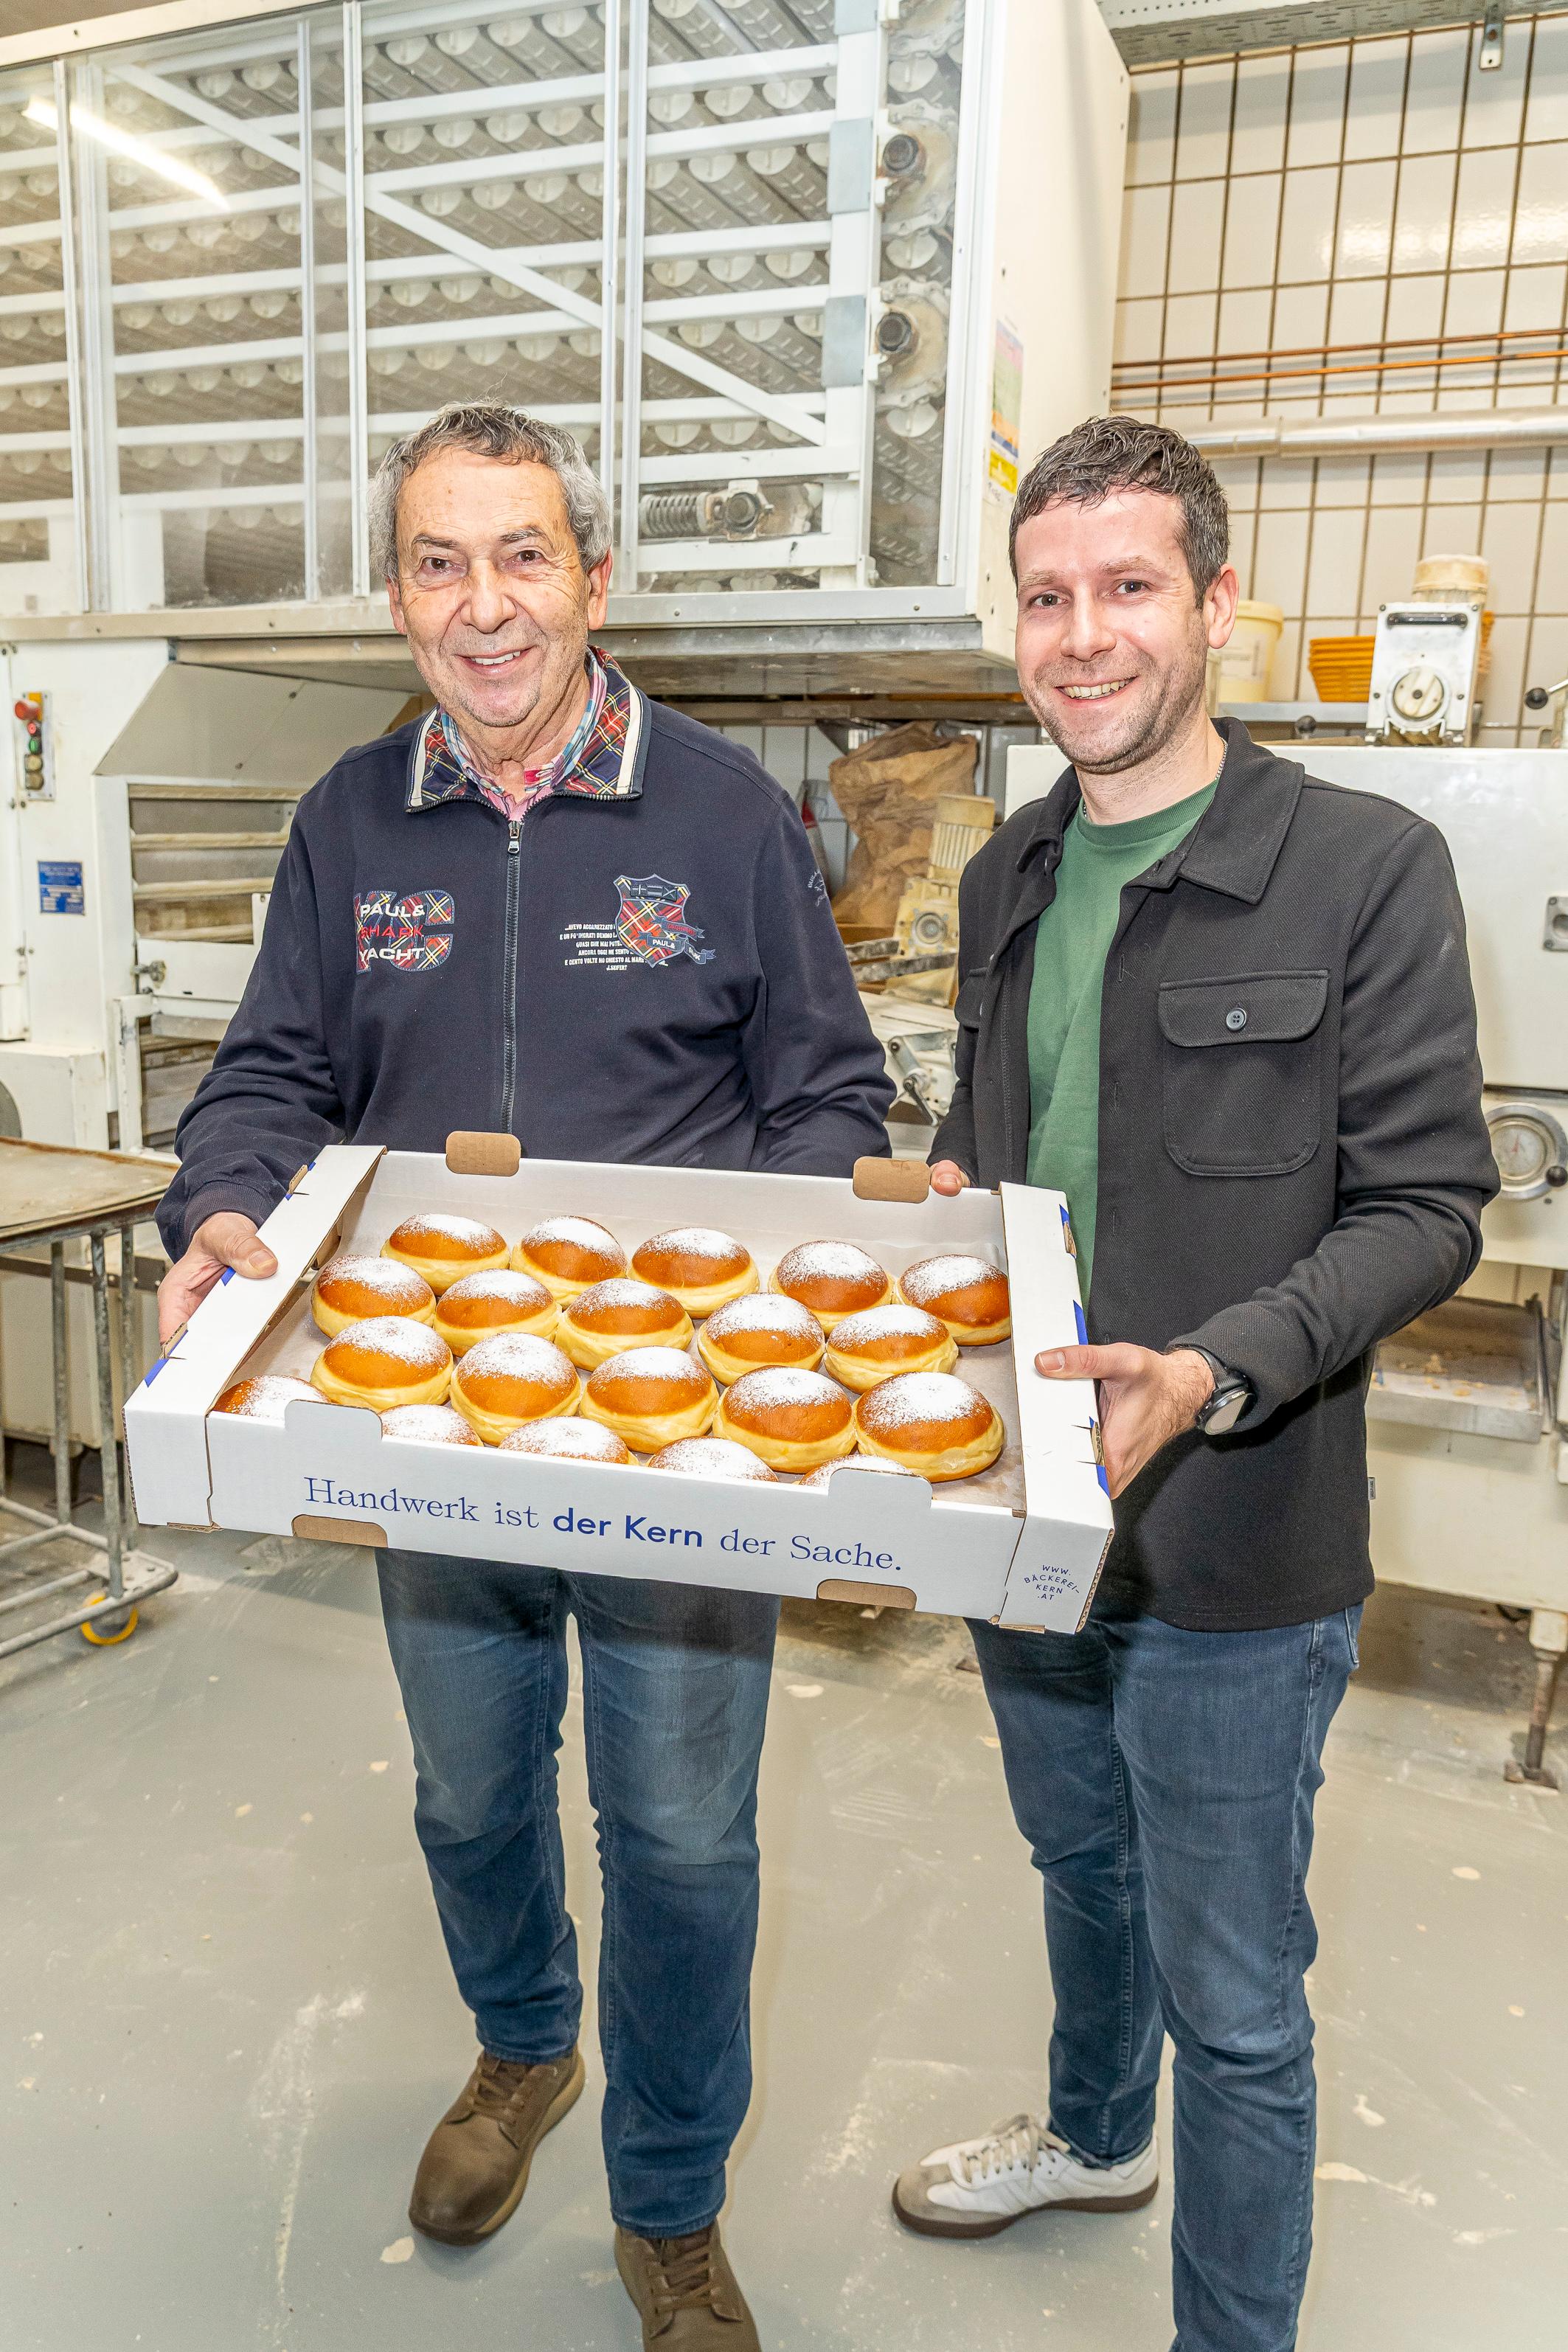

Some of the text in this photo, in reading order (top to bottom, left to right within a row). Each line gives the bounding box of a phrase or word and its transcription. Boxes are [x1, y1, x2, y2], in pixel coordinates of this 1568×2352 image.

[359, 903, 426, 917] PAUL&
[360, 924, 425, 939] SHARK
[358, 947, 426, 960] YACHT
[304, 1477, 901, 1571] Handwerk ist der Kern der Sache.
[1042, 1564, 1071, 1576] WWW.
[1035, 1583, 1063, 1594] KERN
